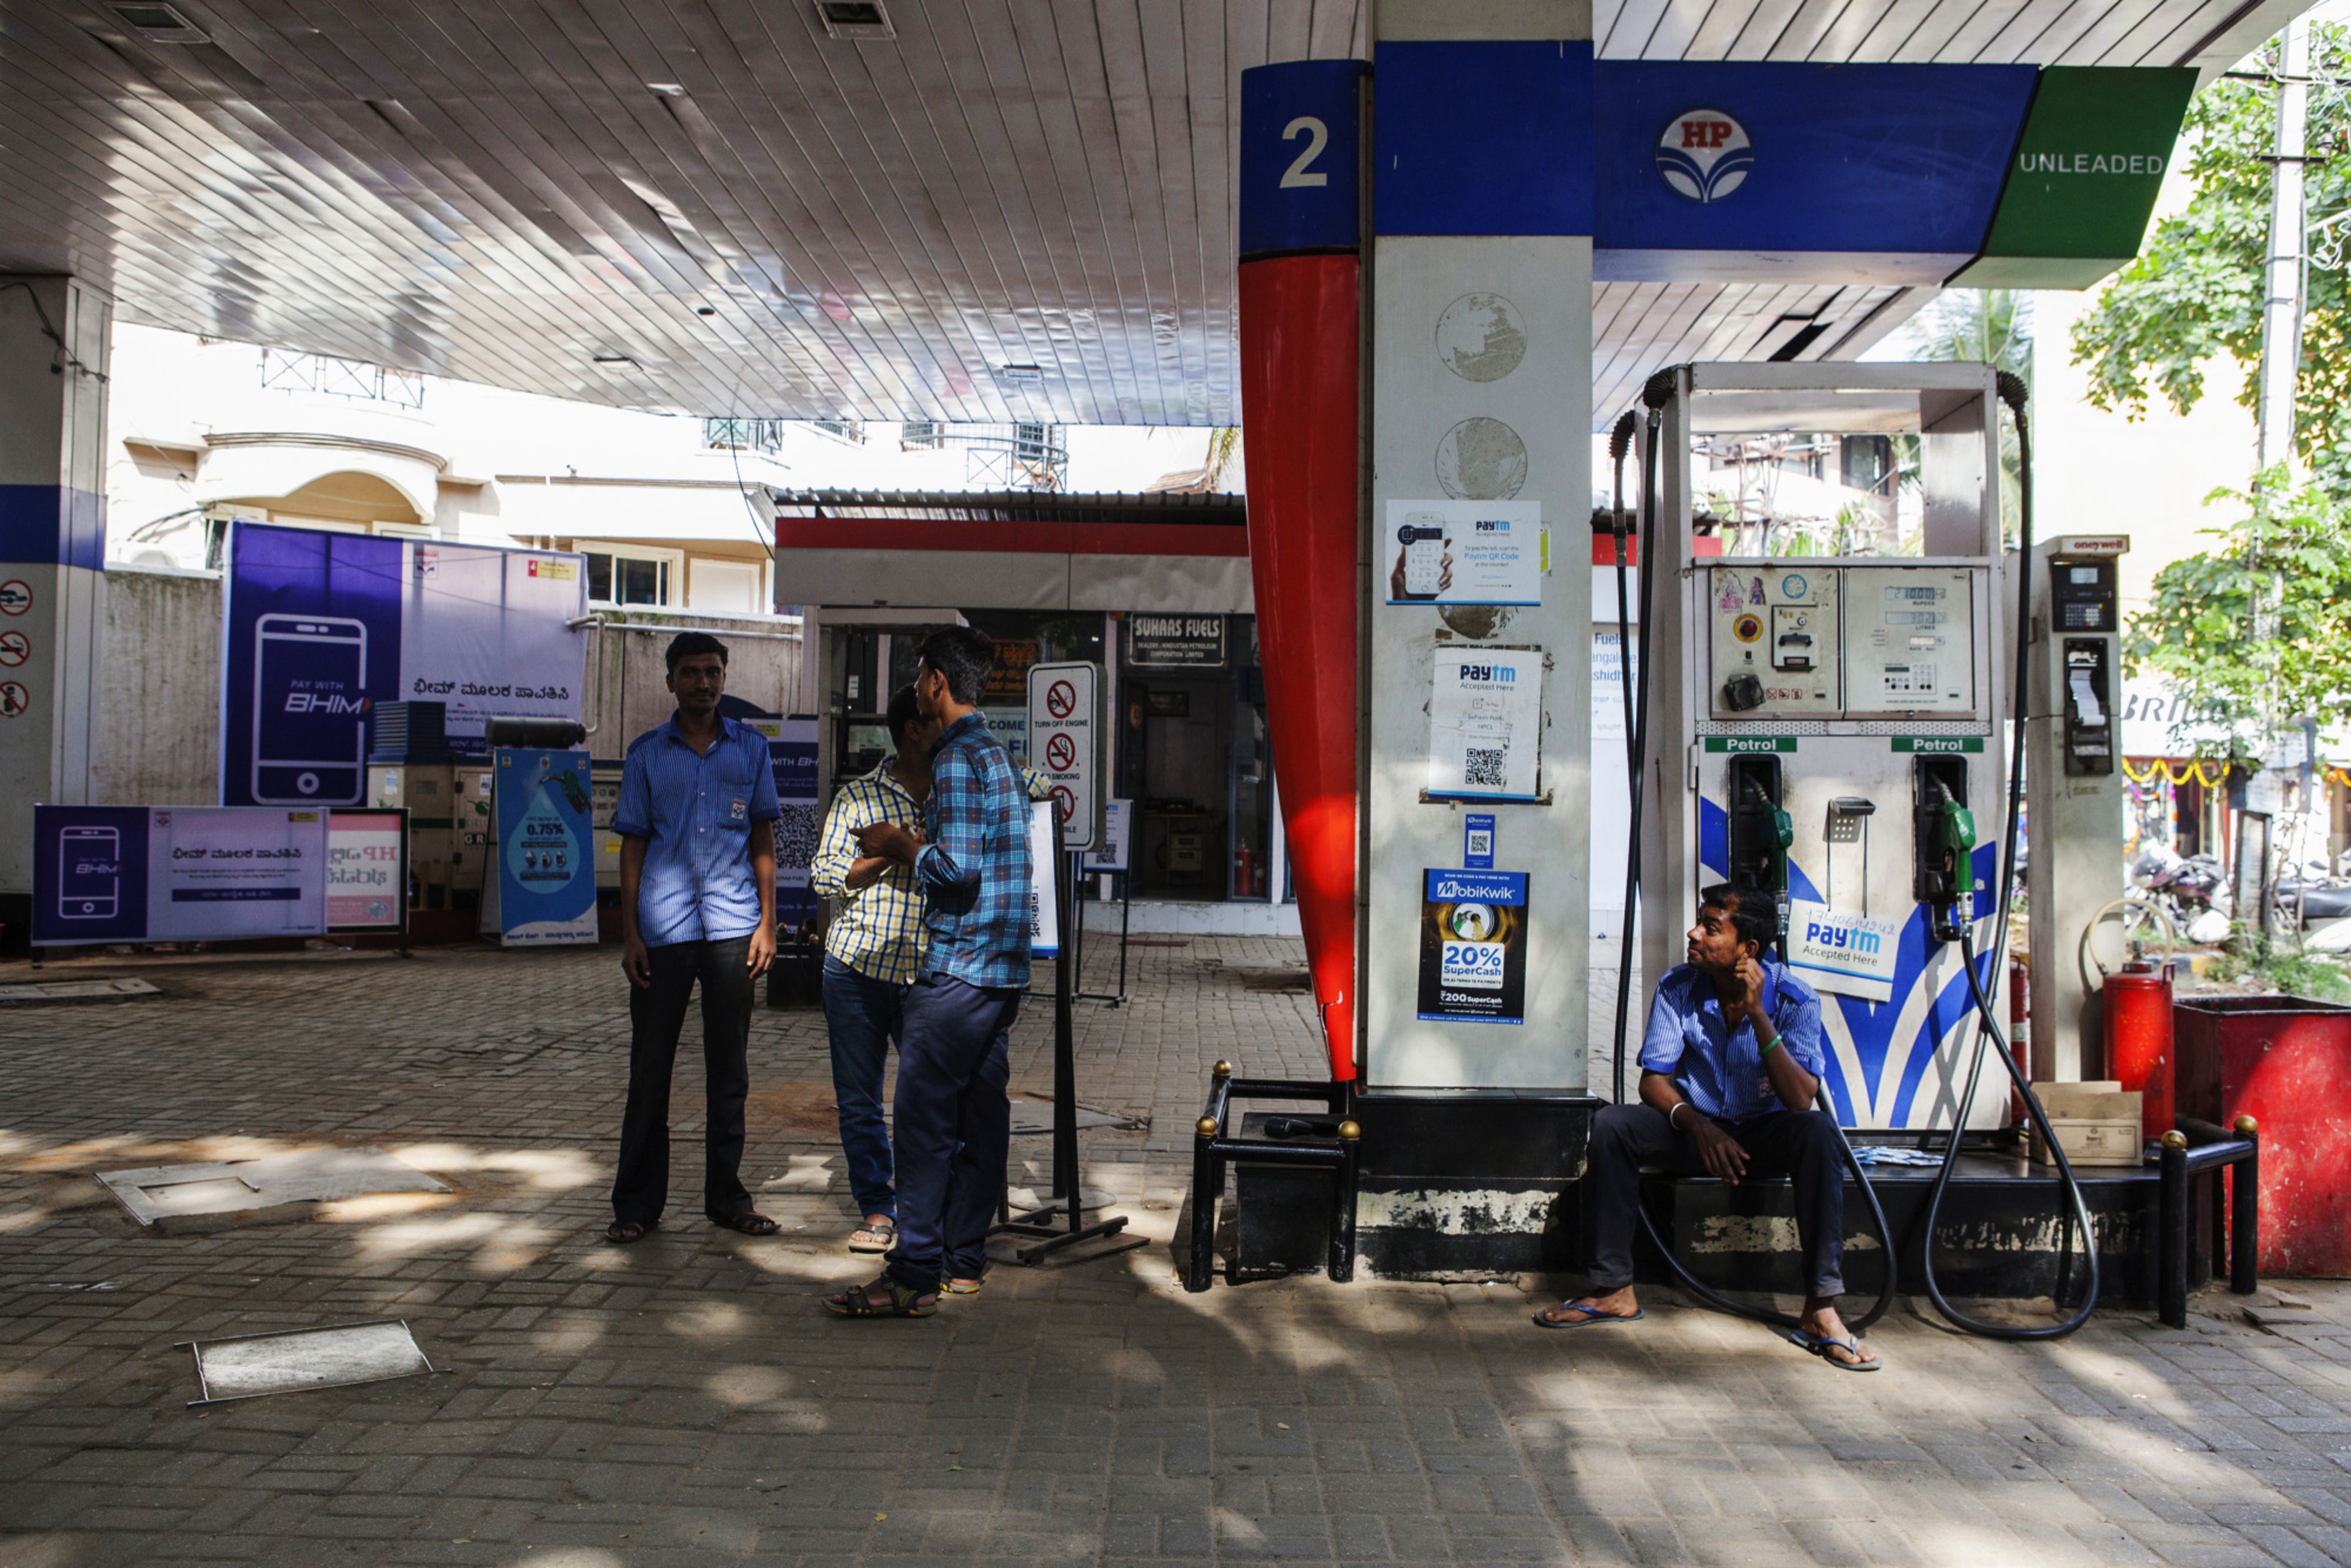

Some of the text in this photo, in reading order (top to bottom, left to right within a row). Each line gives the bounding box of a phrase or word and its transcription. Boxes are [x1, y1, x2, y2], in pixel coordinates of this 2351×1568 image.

[1681, 122, 1732, 148] HP
[1280, 116, 1328, 188] 2
[2020, 154, 2163, 175] UNLEADED
[1136, 618, 1220, 637] SUHAAS FUELS
[290, 680, 345, 690] PAY WITH
[414, 678, 569, 700] ಭೀಮ್ ಮೂಲಕ ಪಾವತಿಸಿ
[1460, 683, 1494, 691] Accepted
[285, 693, 365, 714] BHIM
[989, 720, 1025, 731] COME
[1727, 738, 1776, 751] Petrol
[1913, 738, 1963, 751] Petrol
[526, 824, 564, 835] 0.75%
[1445, 946, 1501, 967] 20%
[1803, 945, 1878, 967] Accepted Here
[1444, 966, 1501, 976] SuperCash
[1467, 996, 1502, 1005] SuperCash
